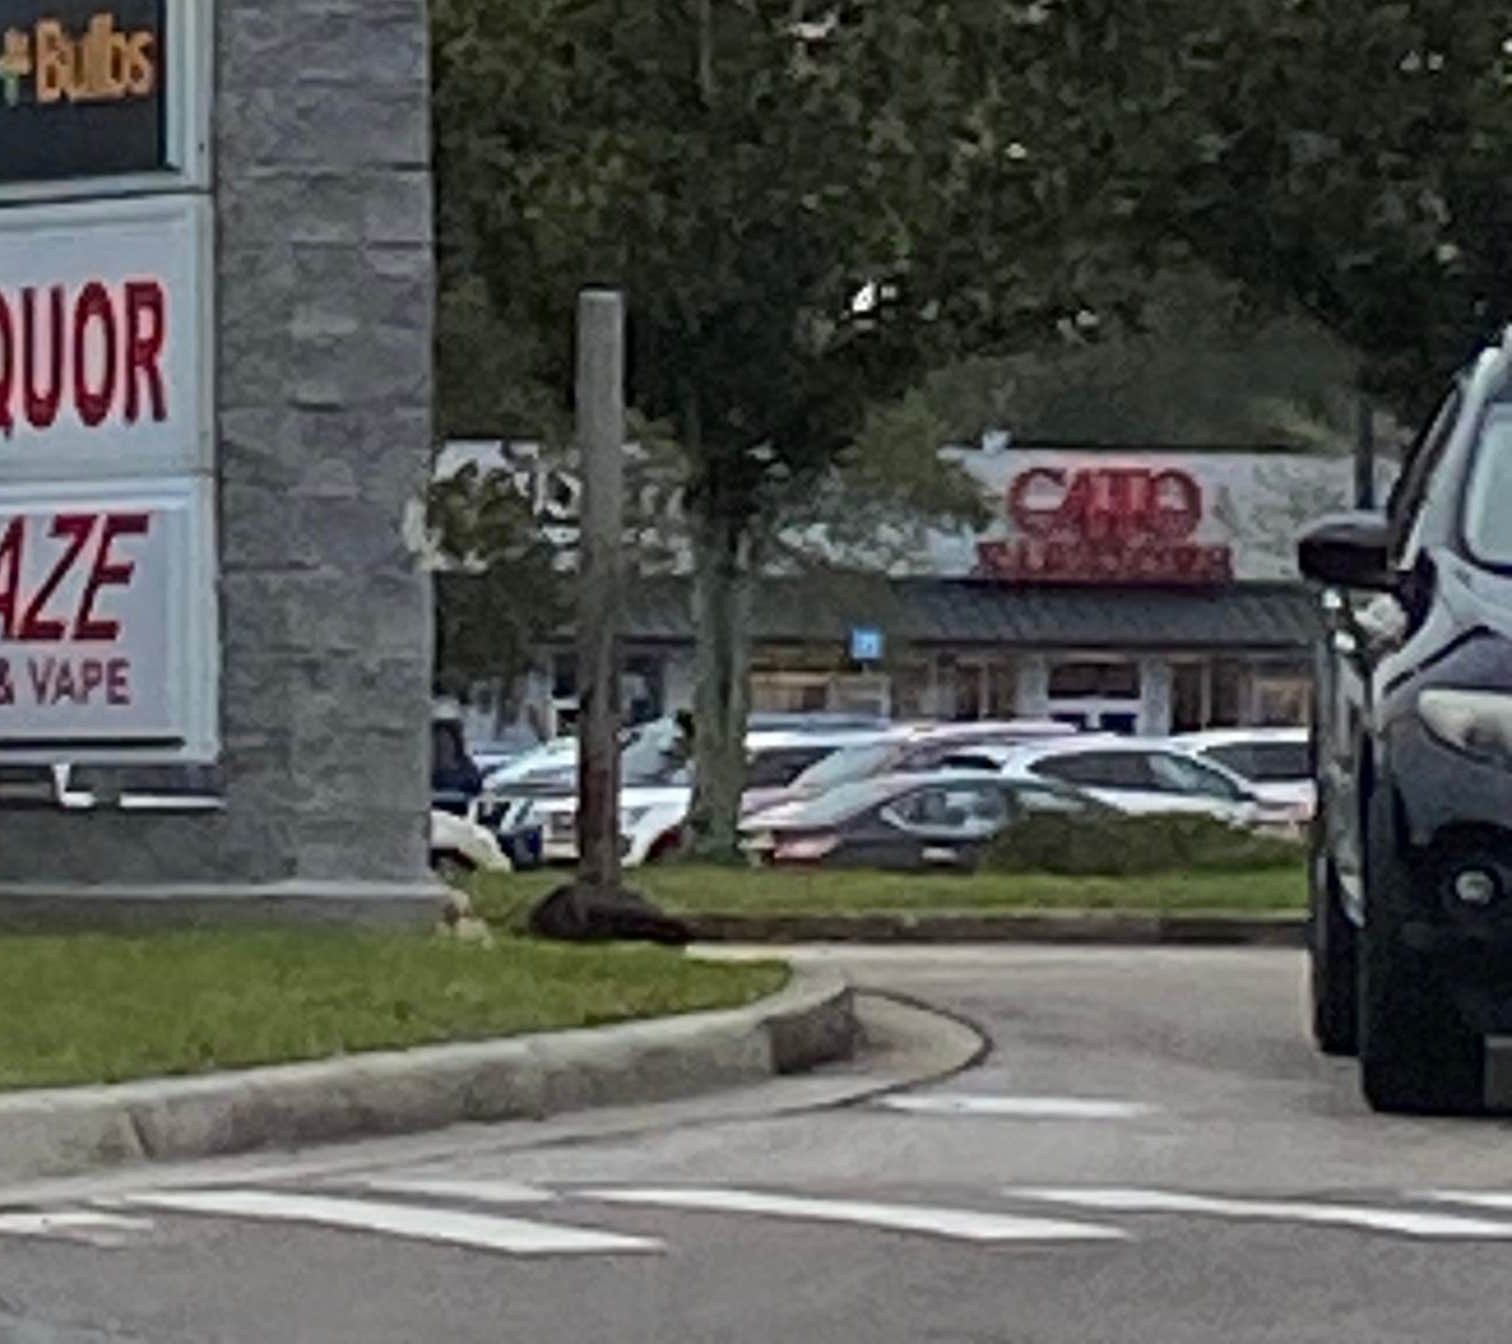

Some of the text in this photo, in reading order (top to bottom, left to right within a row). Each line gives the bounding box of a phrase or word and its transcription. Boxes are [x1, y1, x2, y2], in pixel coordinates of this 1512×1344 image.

[35, 12, 155, 103] Bulbs
[1009, 467, 1203, 541] CATO
[28, 657, 131, 704] VAPE
